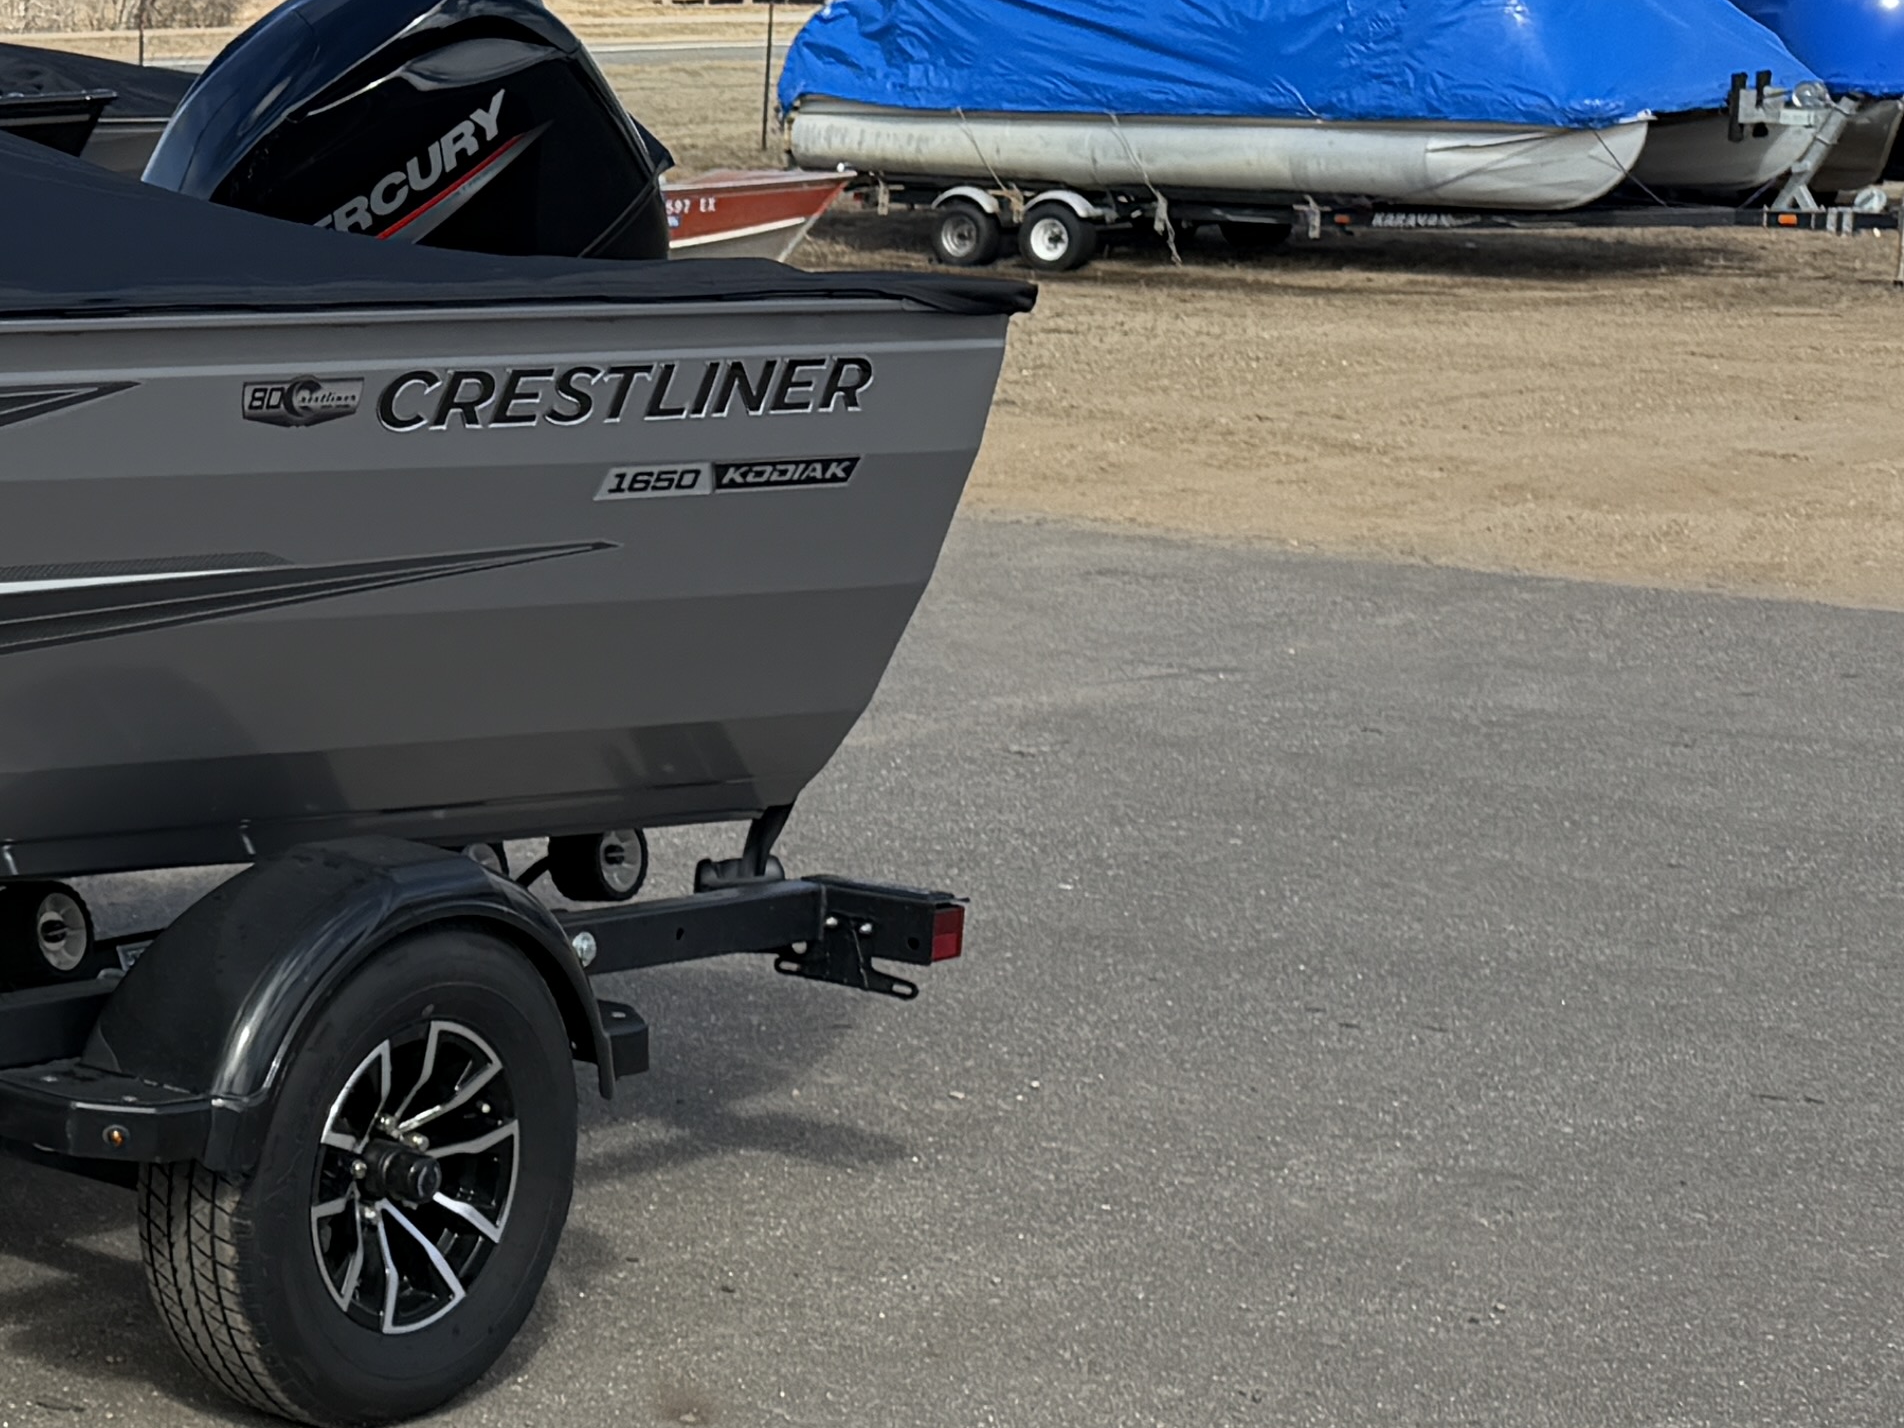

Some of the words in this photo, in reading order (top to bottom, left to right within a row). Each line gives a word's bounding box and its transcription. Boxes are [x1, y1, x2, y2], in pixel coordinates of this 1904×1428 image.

[248, 386, 286, 410] 80
[376, 356, 874, 433] CRESTLINER
[607, 468, 701, 494] 1650
[720, 461, 850, 485] KODIAK
